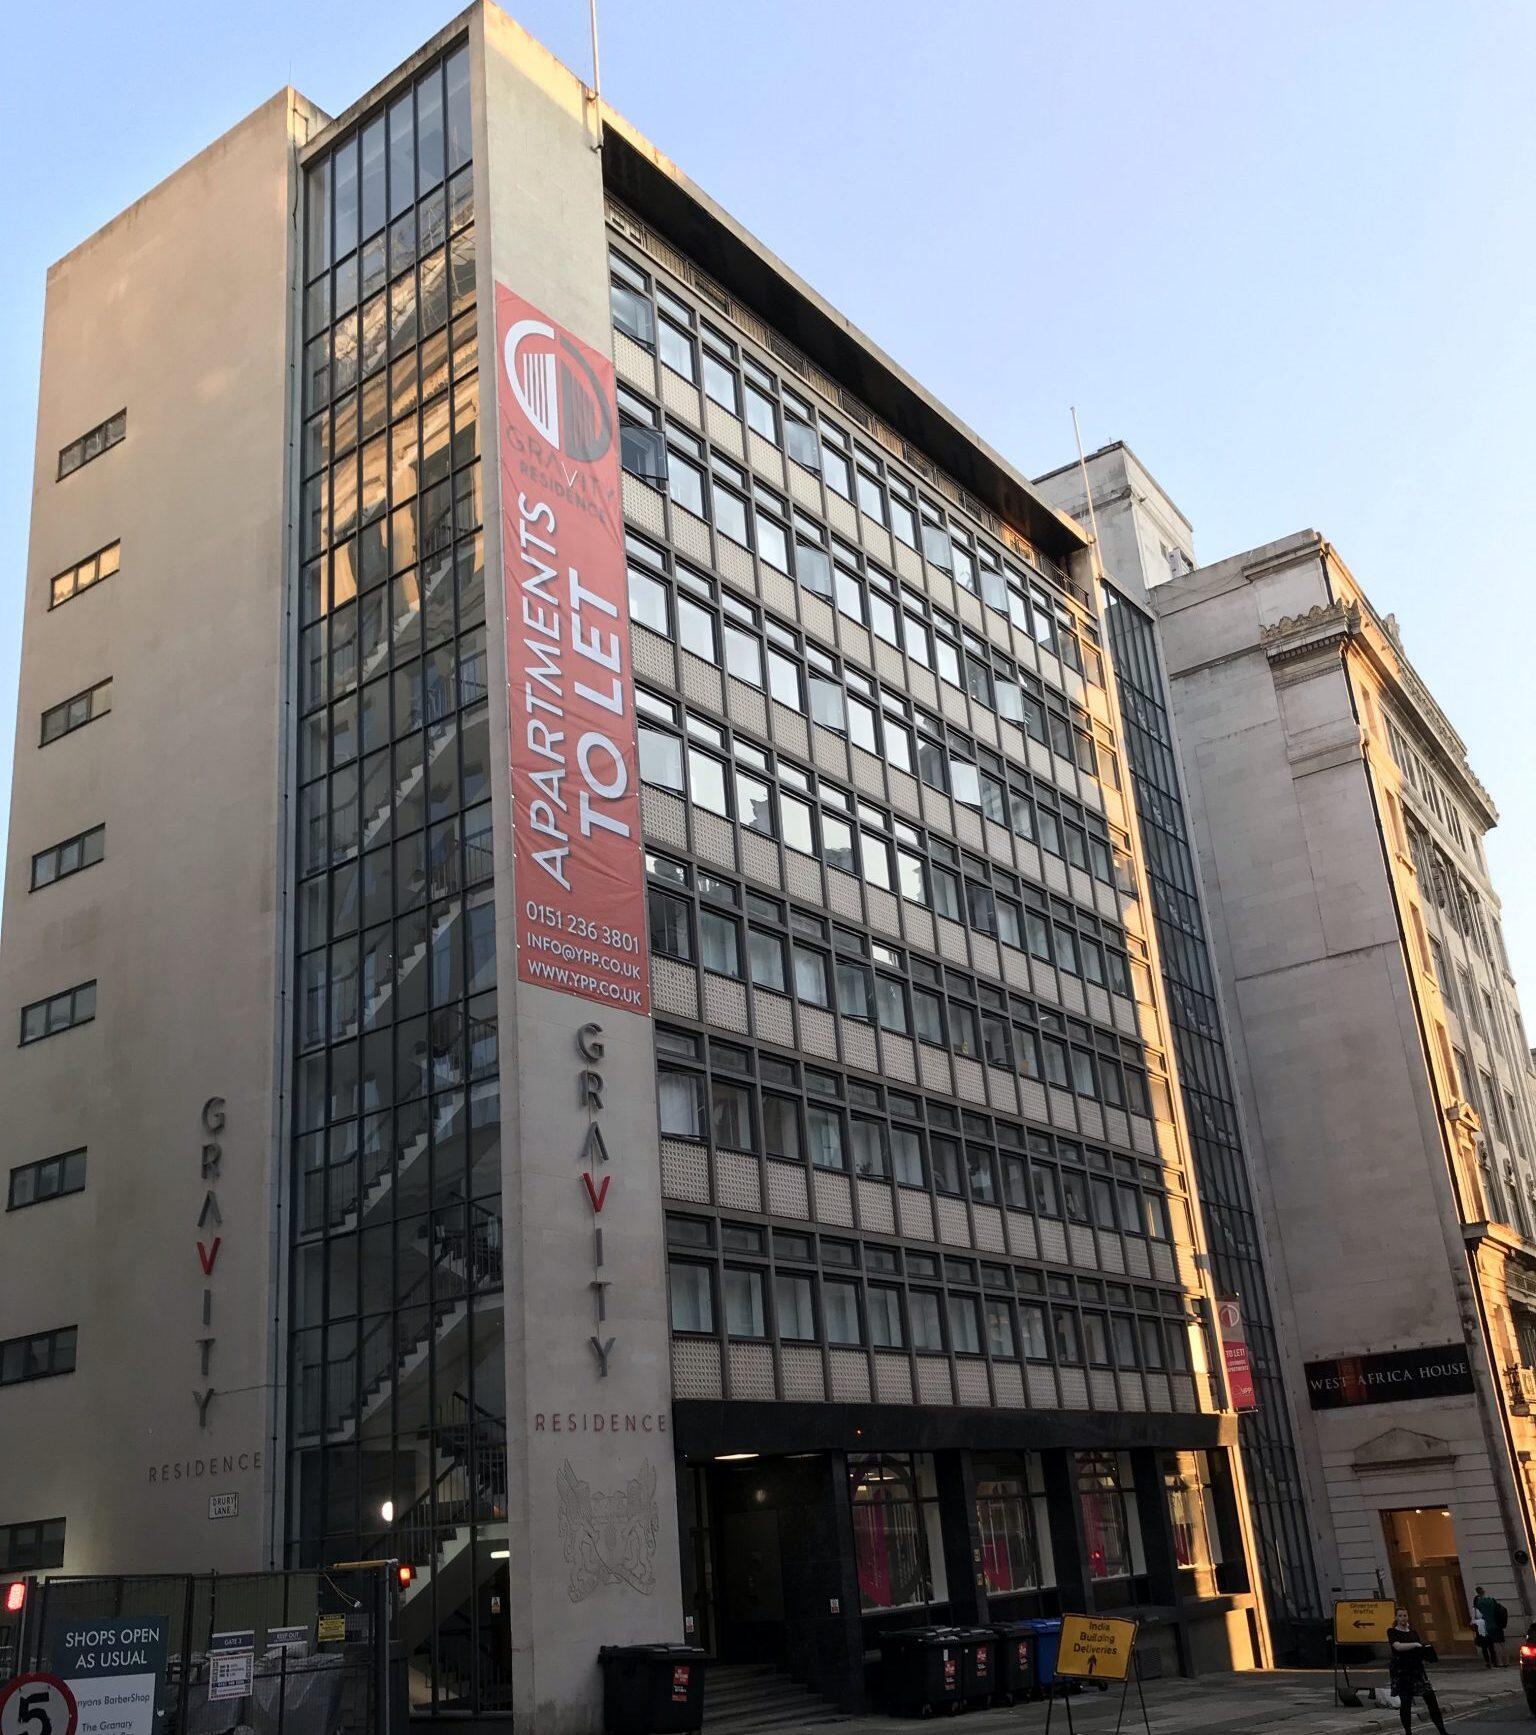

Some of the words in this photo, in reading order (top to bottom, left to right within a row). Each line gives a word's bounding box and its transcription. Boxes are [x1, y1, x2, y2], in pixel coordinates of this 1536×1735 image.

[505, 424, 616, 500] GRAVITY
[519, 460, 606, 525] RESIDENCE
[568, 567, 624, 717] LET
[518, 491, 572, 892] APARTMENTS
[577, 730, 631, 838] TO
[526, 900, 562, 929] 0151
[567, 914, 598, 940] 236
[601, 926, 639, 954] 3801
[527, 931, 641, 980] INFO@YPP.CO.UK
[527, 959, 641, 1006] WWW.YPP.CO.UK
[576, 1022, 616, 1378] GRAVITY
[193, 1096, 226, 1427] GRAVITY
[1225, 1350, 1234, 1358] TO
[1310, 1376, 1347, 1392] WEST
[1358, 1369, 1413, 1387] AFRICA
[1419, 1362, 1468, 1379] HOUSE
[535, 1413, 668, 1433] RESIDENCE
[148, 1452, 262, 1481] RESIDENCE
[212, 1497, 235, 1507] DRURY
[214, 1506, 231, 1517] LANE
[65, 1630, 116, 1647] SHOPS
[121, 1627, 160, 1644] OPEN
[288, 1631, 299, 1639] OUT
[1080, 1632, 1115, 1644] Building
[1089, 1621, 1111, 1631] India
[76, 1653, 95, 1669] AS
[100, 1650, 148, 1667] USUAL
[1073, 1643, 1118, 1655] Deliveries
[18, 1691, 52, 1735] 5
[104, 1692, 150, 1706] BarberShop
[82, 1723, 97, 1733] The
[100, 1720, 133, 1731] Granary
